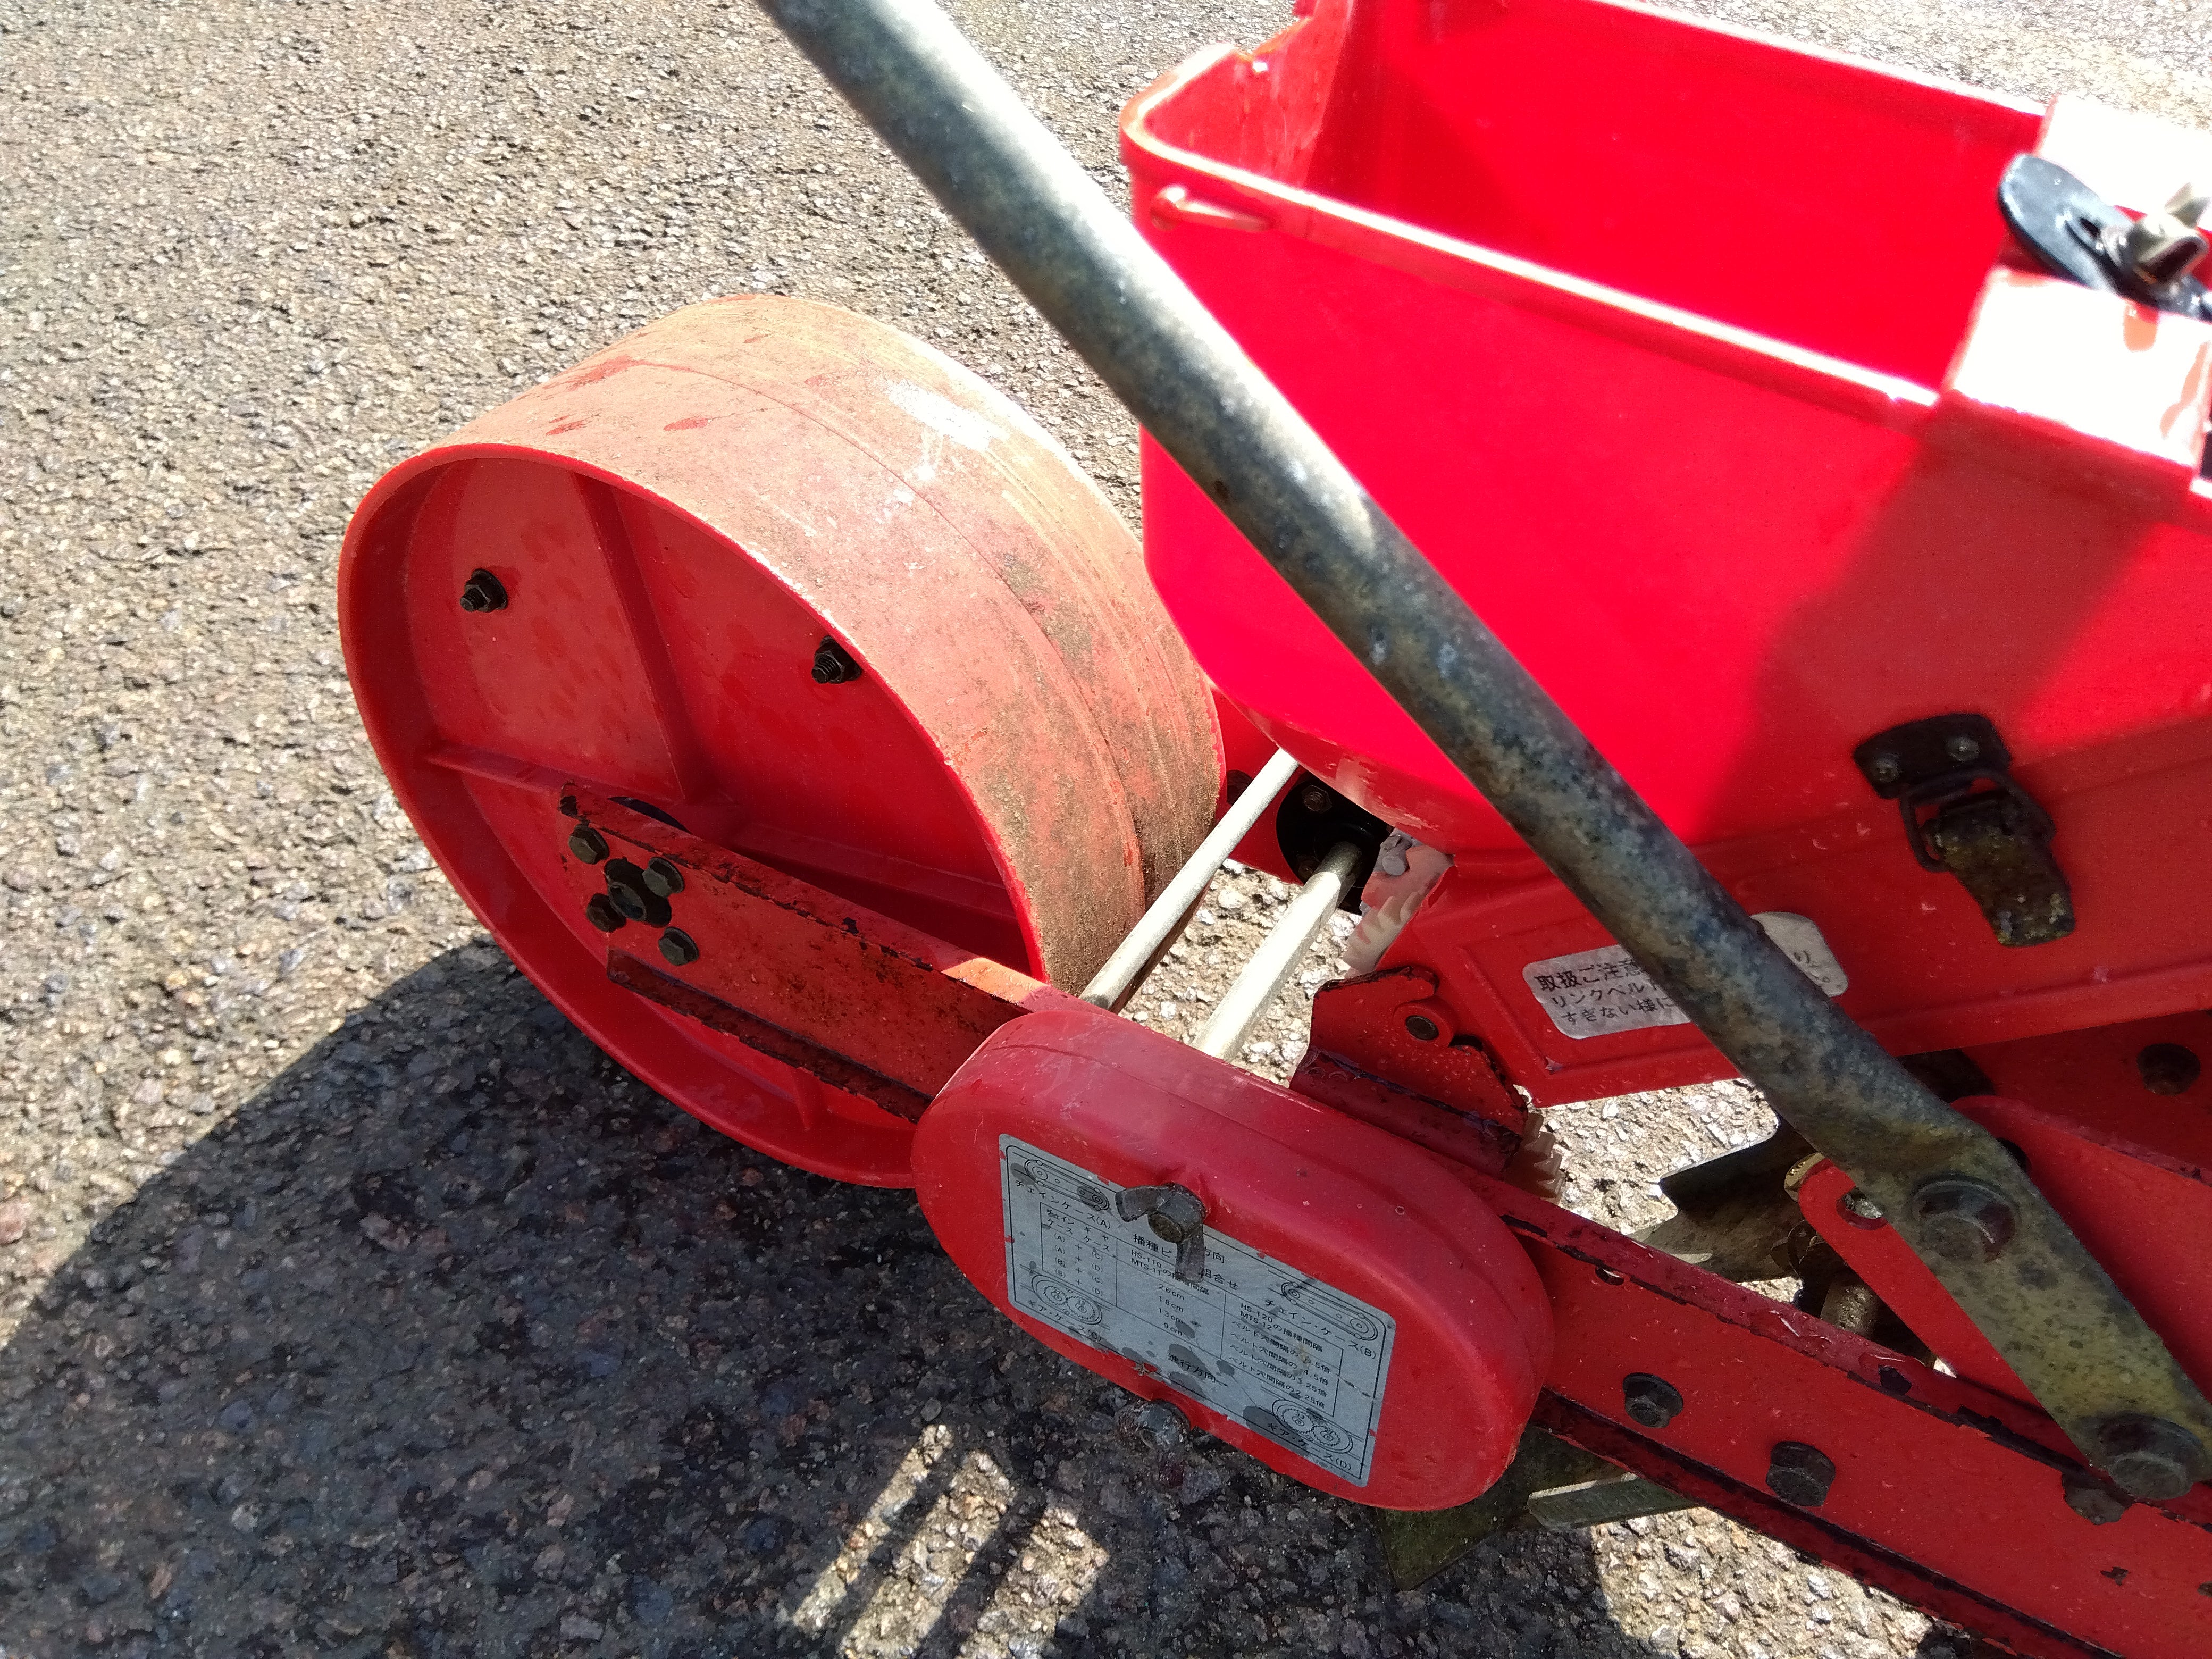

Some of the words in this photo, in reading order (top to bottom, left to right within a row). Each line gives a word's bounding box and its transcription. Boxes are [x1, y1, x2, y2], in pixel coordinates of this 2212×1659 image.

[1158, 1283, 1184, 1301] 26cm
[1158, 1295, 1184, 1313] 18cm
[1158, 1306, 1184, 1325] 13cm
[1163, 1321, 1183, 1336] 9cm
